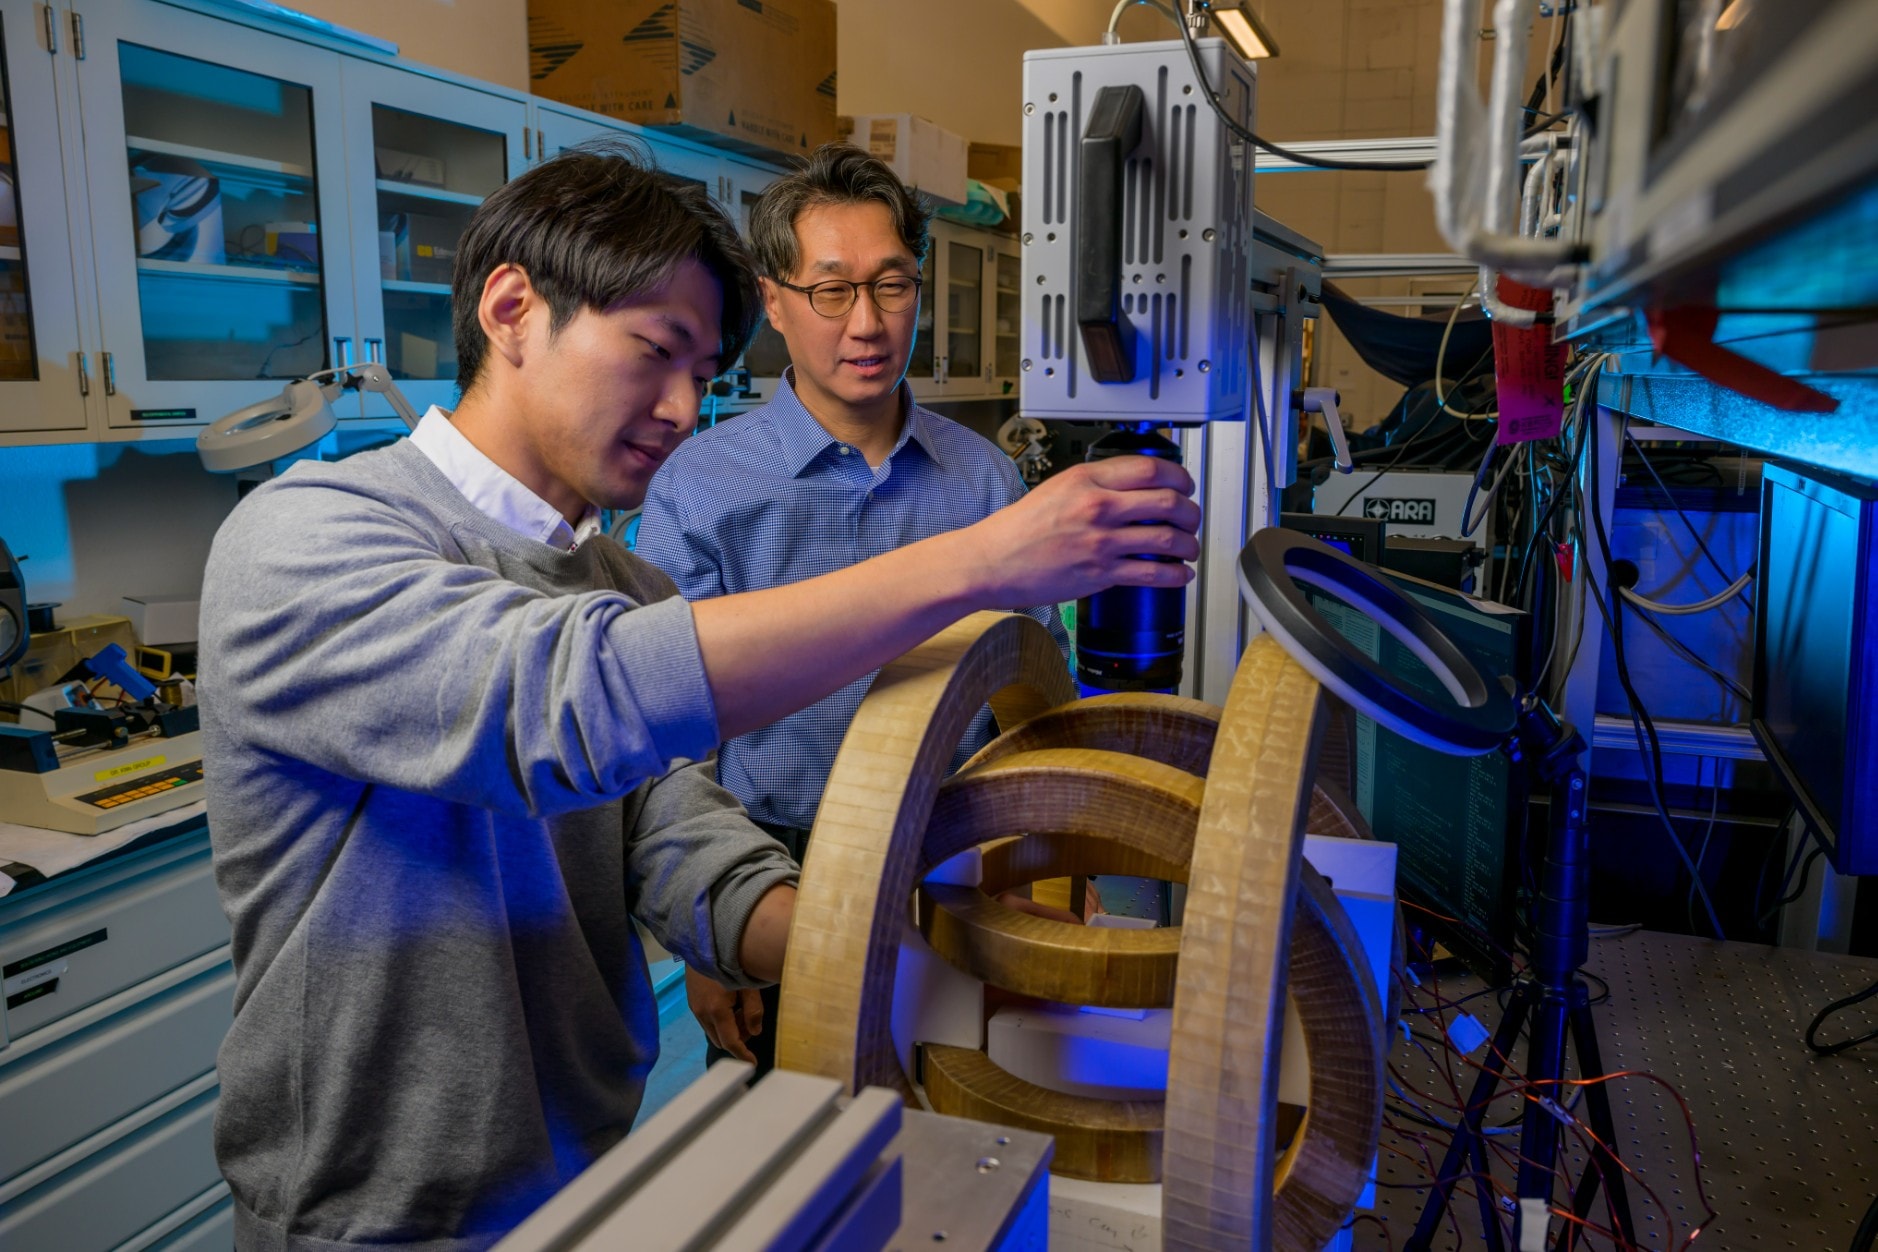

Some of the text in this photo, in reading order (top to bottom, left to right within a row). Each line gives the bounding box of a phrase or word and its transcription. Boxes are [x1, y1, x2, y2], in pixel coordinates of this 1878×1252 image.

[601, 103, 624, 113] WITH
[628, 100, 653, 110] CARE
[1391, 500, 1432, 520] ARA
